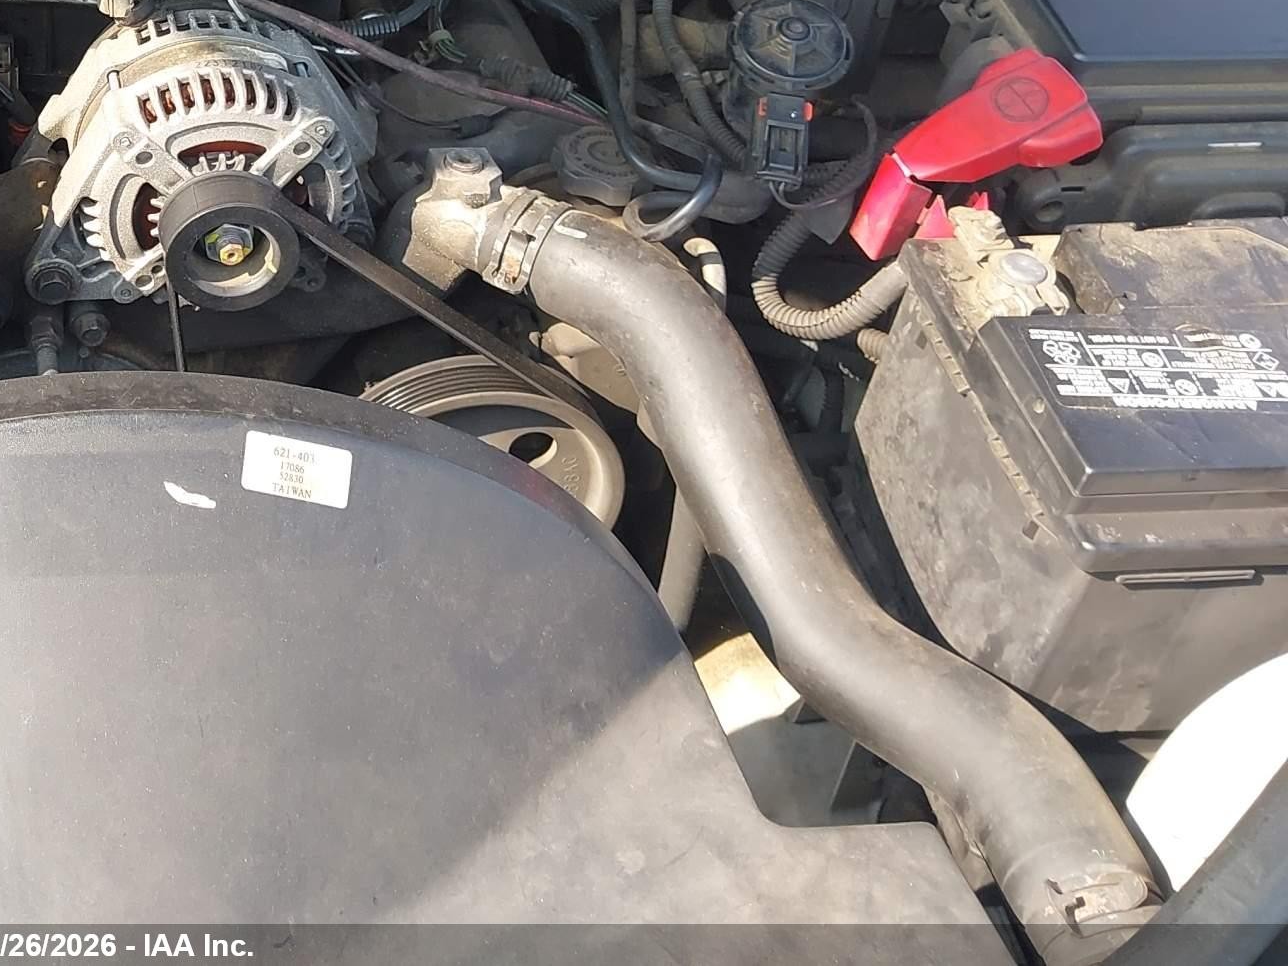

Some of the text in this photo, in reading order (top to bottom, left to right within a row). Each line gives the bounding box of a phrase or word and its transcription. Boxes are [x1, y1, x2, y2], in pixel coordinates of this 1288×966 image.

[280, 461, 305, 474] 17086
[279, 471, 304, 483] 52830
[272, 483, 312, 498] TAIWAN
